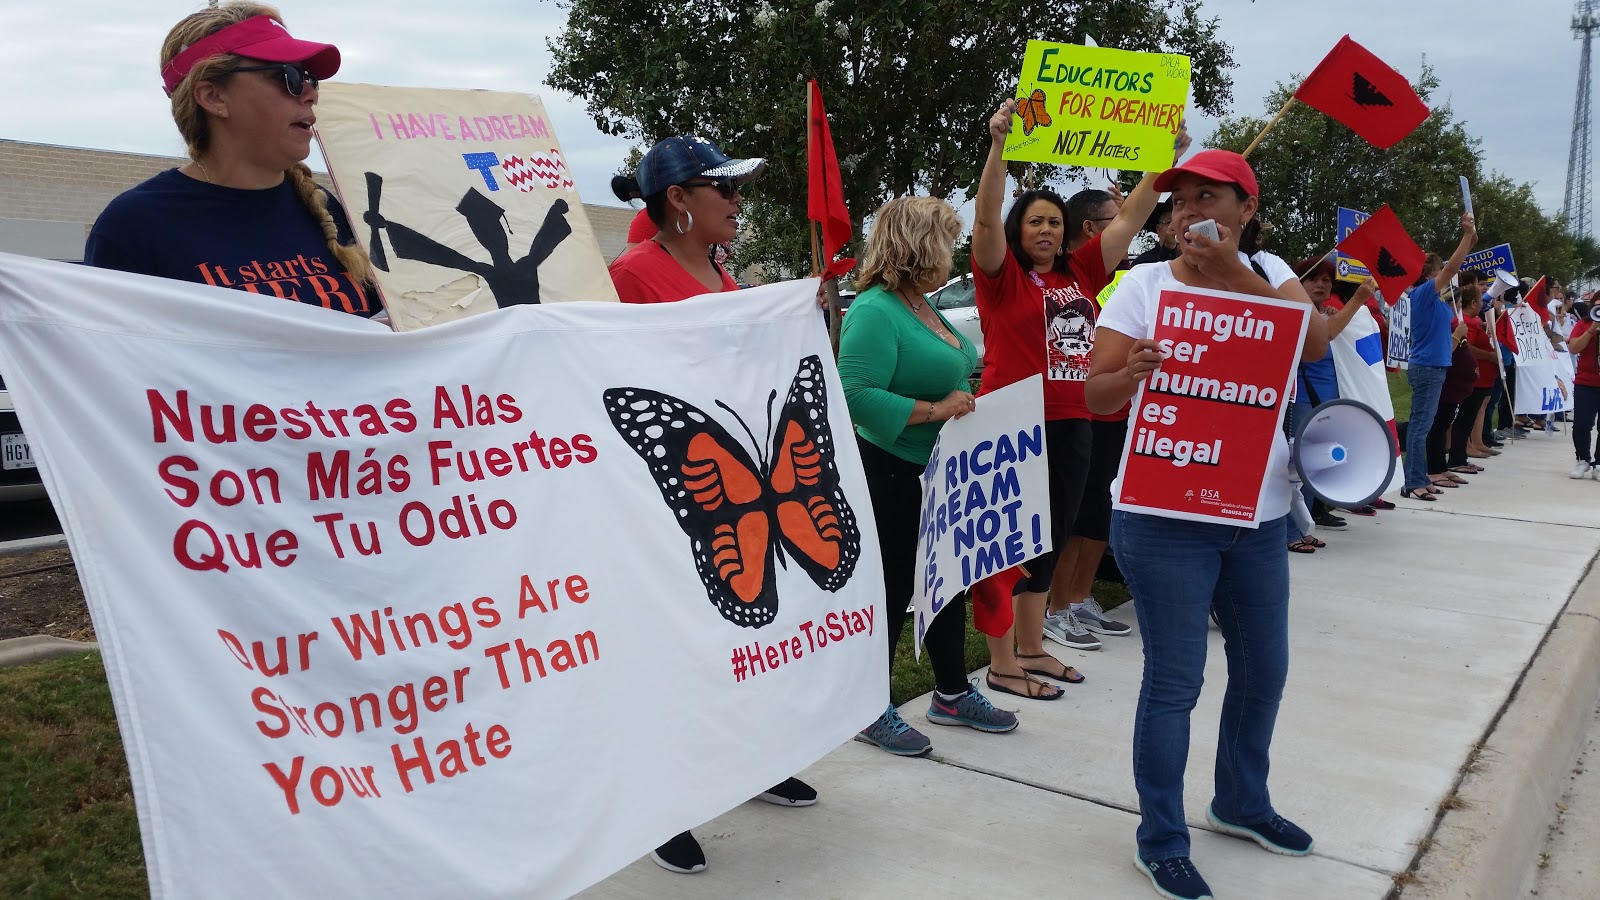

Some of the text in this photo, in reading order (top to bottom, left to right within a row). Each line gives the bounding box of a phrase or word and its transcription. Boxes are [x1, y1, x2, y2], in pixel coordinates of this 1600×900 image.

[1037, 48, 1154, 94] EDUCATORS
[1160, 55, 1180, 67] DACA
[369, 112, 551, 142] I HAVE A DREAM
[1058, 91, 1185, 135] FOR DREAMERS
[1052, 130, 1092, 156] NOT
[195, 254, 328, 288] It starts
[1462, 251, 1494, 266] SALUD
[1161, 302, 1275, 342] ningún
[1158, 339, 1209, 364] ser
[1517, 337, 1543, 363] DACA
[1149, 368, 1278, 407] humano
[147, 385, 523, 443] Nuestras Alas
[1142, 403, 1179, 426] es
[1135, 427, 1223, 468] ilegal
[158, 431, 599, 508] Son Más Fuertes
[925, 466, 1021, 561] DREAM
[1200, 488, 1220, 499] DSA
[1221, 508, 1253, 518] dsausa.org
[173, 493, 518, 573] Que Tu Odio
[924, 499, 1023, 598] IS NOT
[331, 596, 502, 662] Wings
[518, 574, 591, 620] Are
[484, 630, 600, 691] Than
[731, 605, 876, 683] #HereToStay
[263, 722, 513, 815] Your Hate
